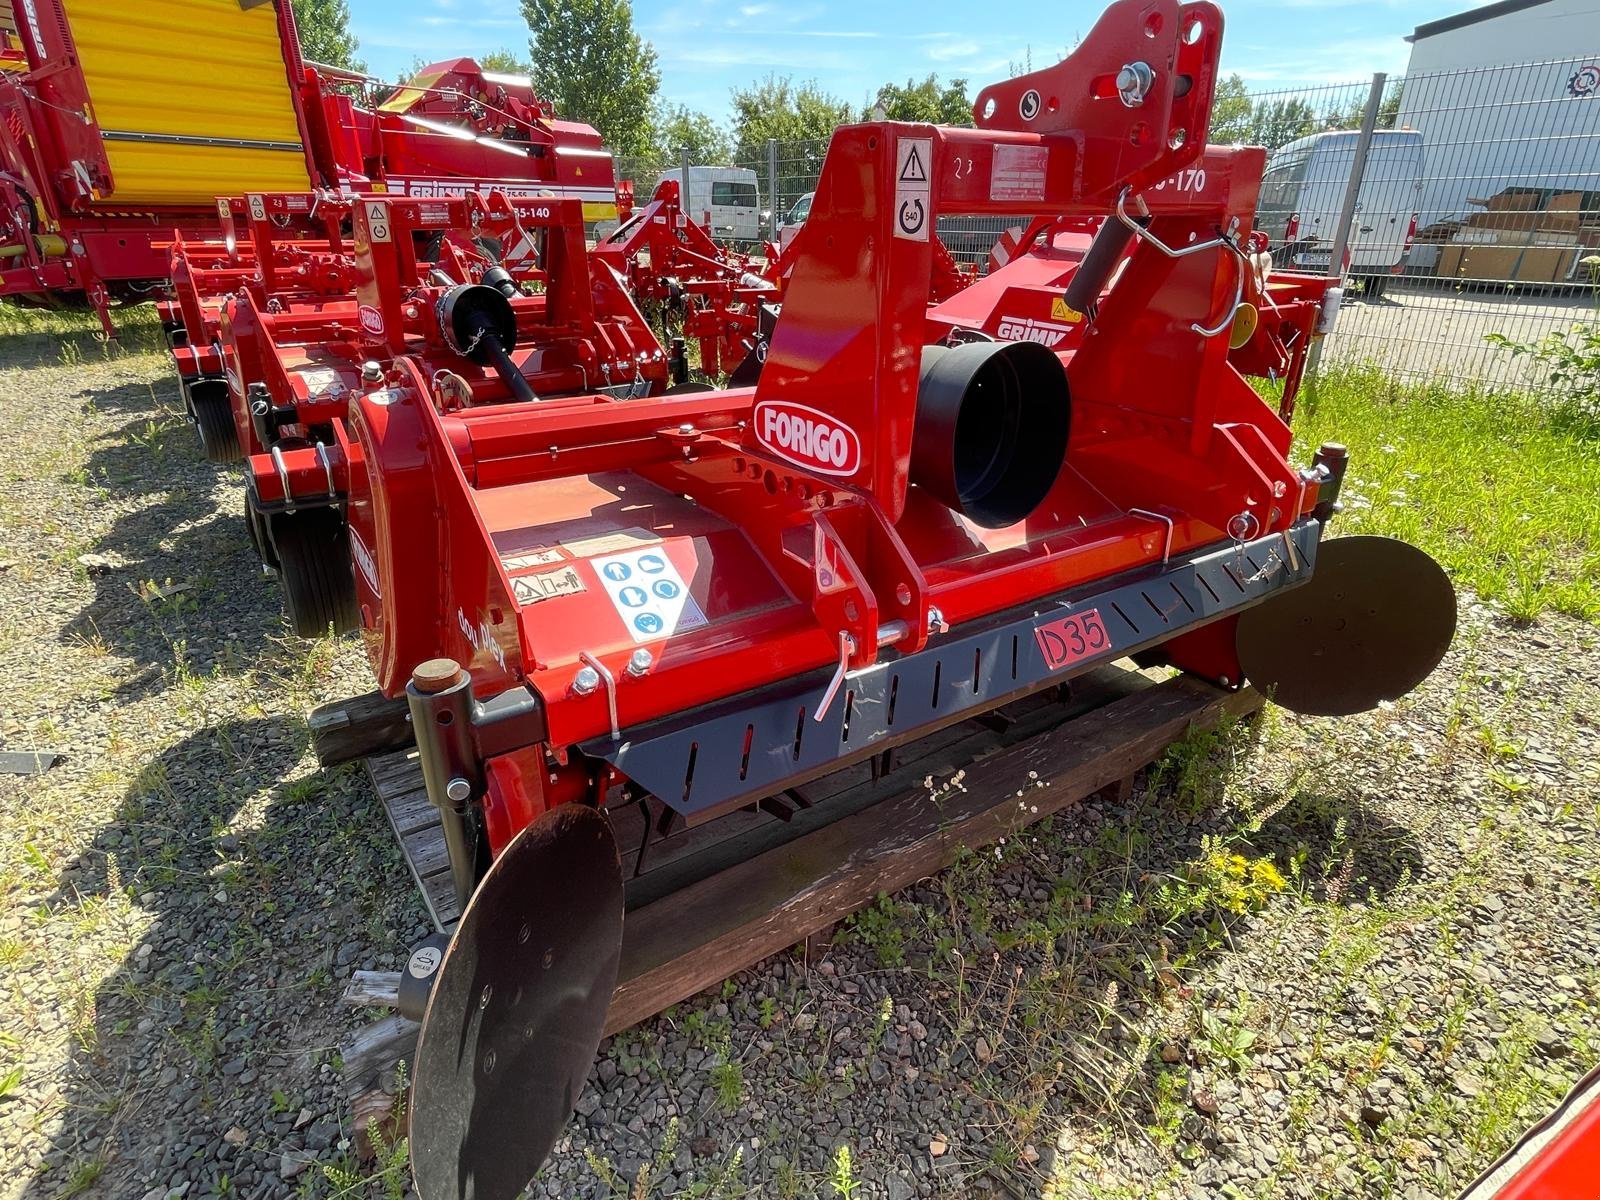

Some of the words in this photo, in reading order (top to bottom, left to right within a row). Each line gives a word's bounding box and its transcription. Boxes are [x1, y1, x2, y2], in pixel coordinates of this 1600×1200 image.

[953, 157, 973, 179] 23
[905, 211, 918, 221] 540
[764, 407, 848, 468] FORIGO
[1040, 612, 1105, 664] D35
